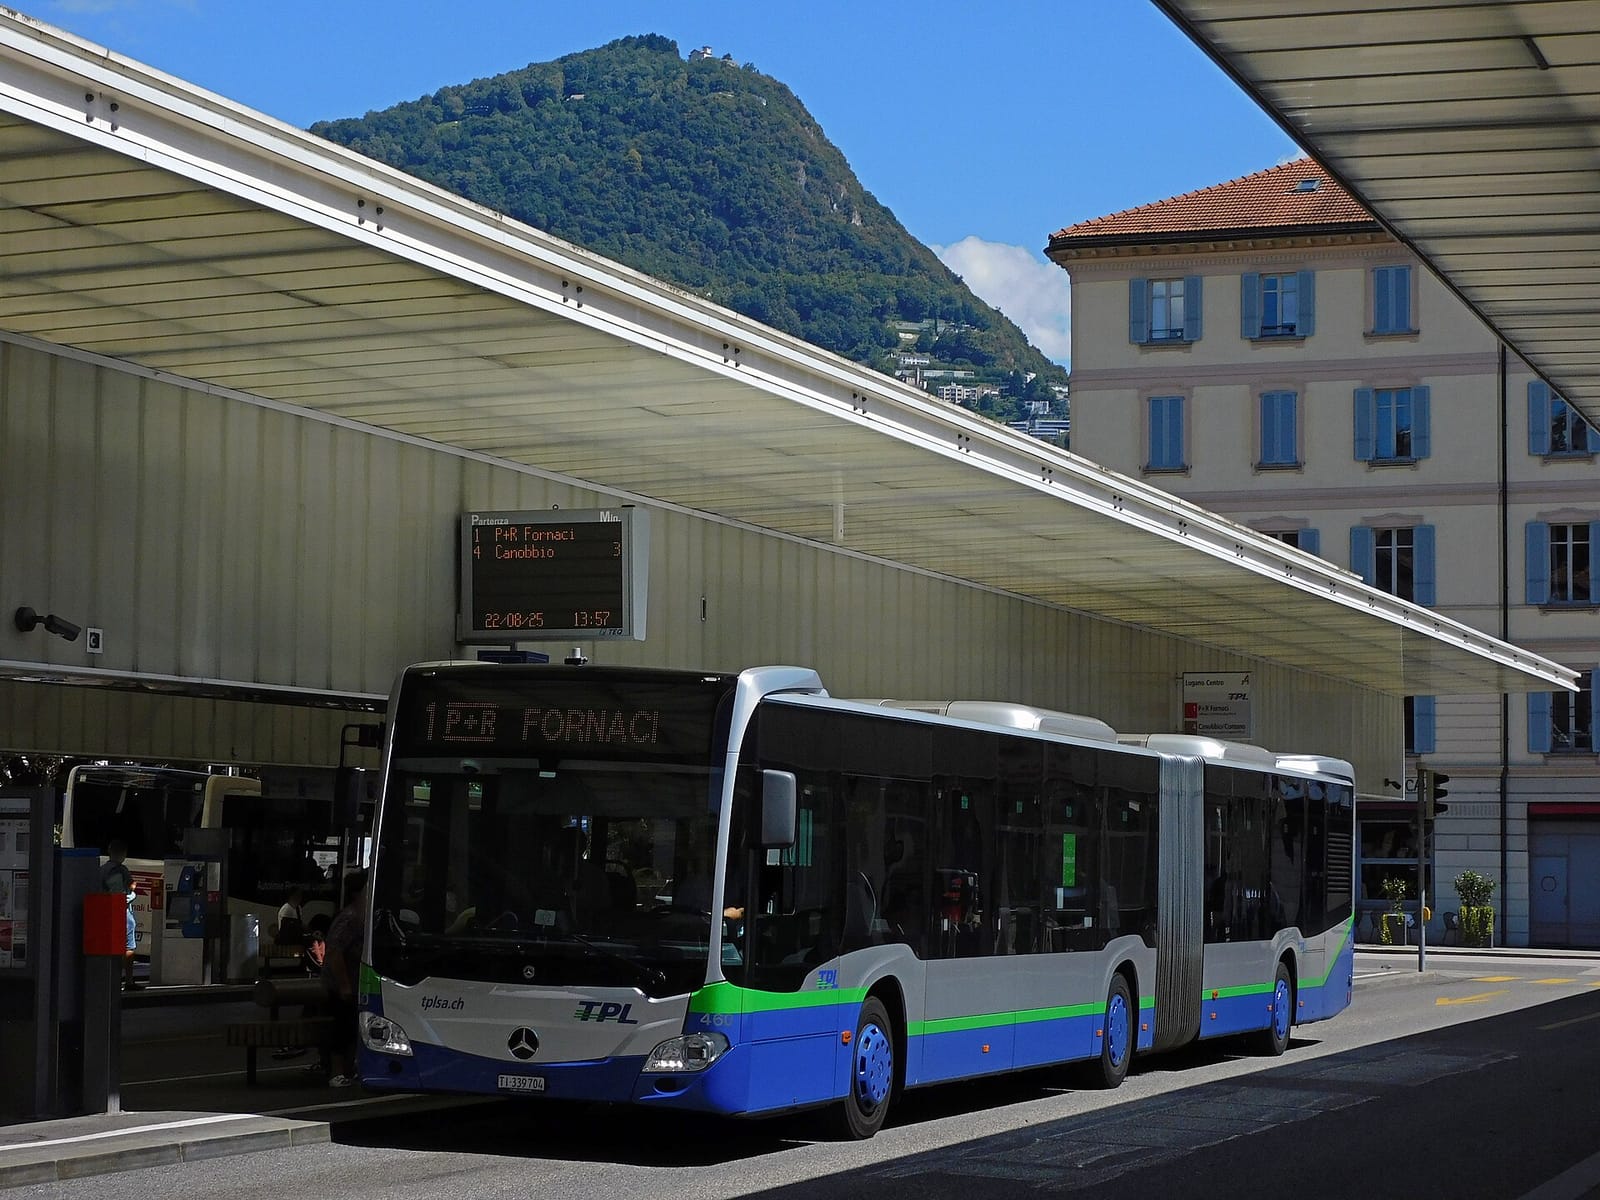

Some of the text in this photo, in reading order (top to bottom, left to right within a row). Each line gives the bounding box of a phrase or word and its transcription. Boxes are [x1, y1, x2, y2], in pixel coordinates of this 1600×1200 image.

[471, 511, 621, 526] Partenza Min.
[474, 527, 575, 542] 1 P+R Fornaci
[473, 541, 621, 560] 4 Canobbio 3
[484, 611, 610, 628] 22/08/25 13:57
[1228, 693, 1249, 701] TPL
[425, 701, 660, 744] 1 P+R FORNACI
[421, 995, 465, 1011] tplsa.ch
[574, 1000, 639, 1025] TPL
[700, 1013, 733, 1028] 460
